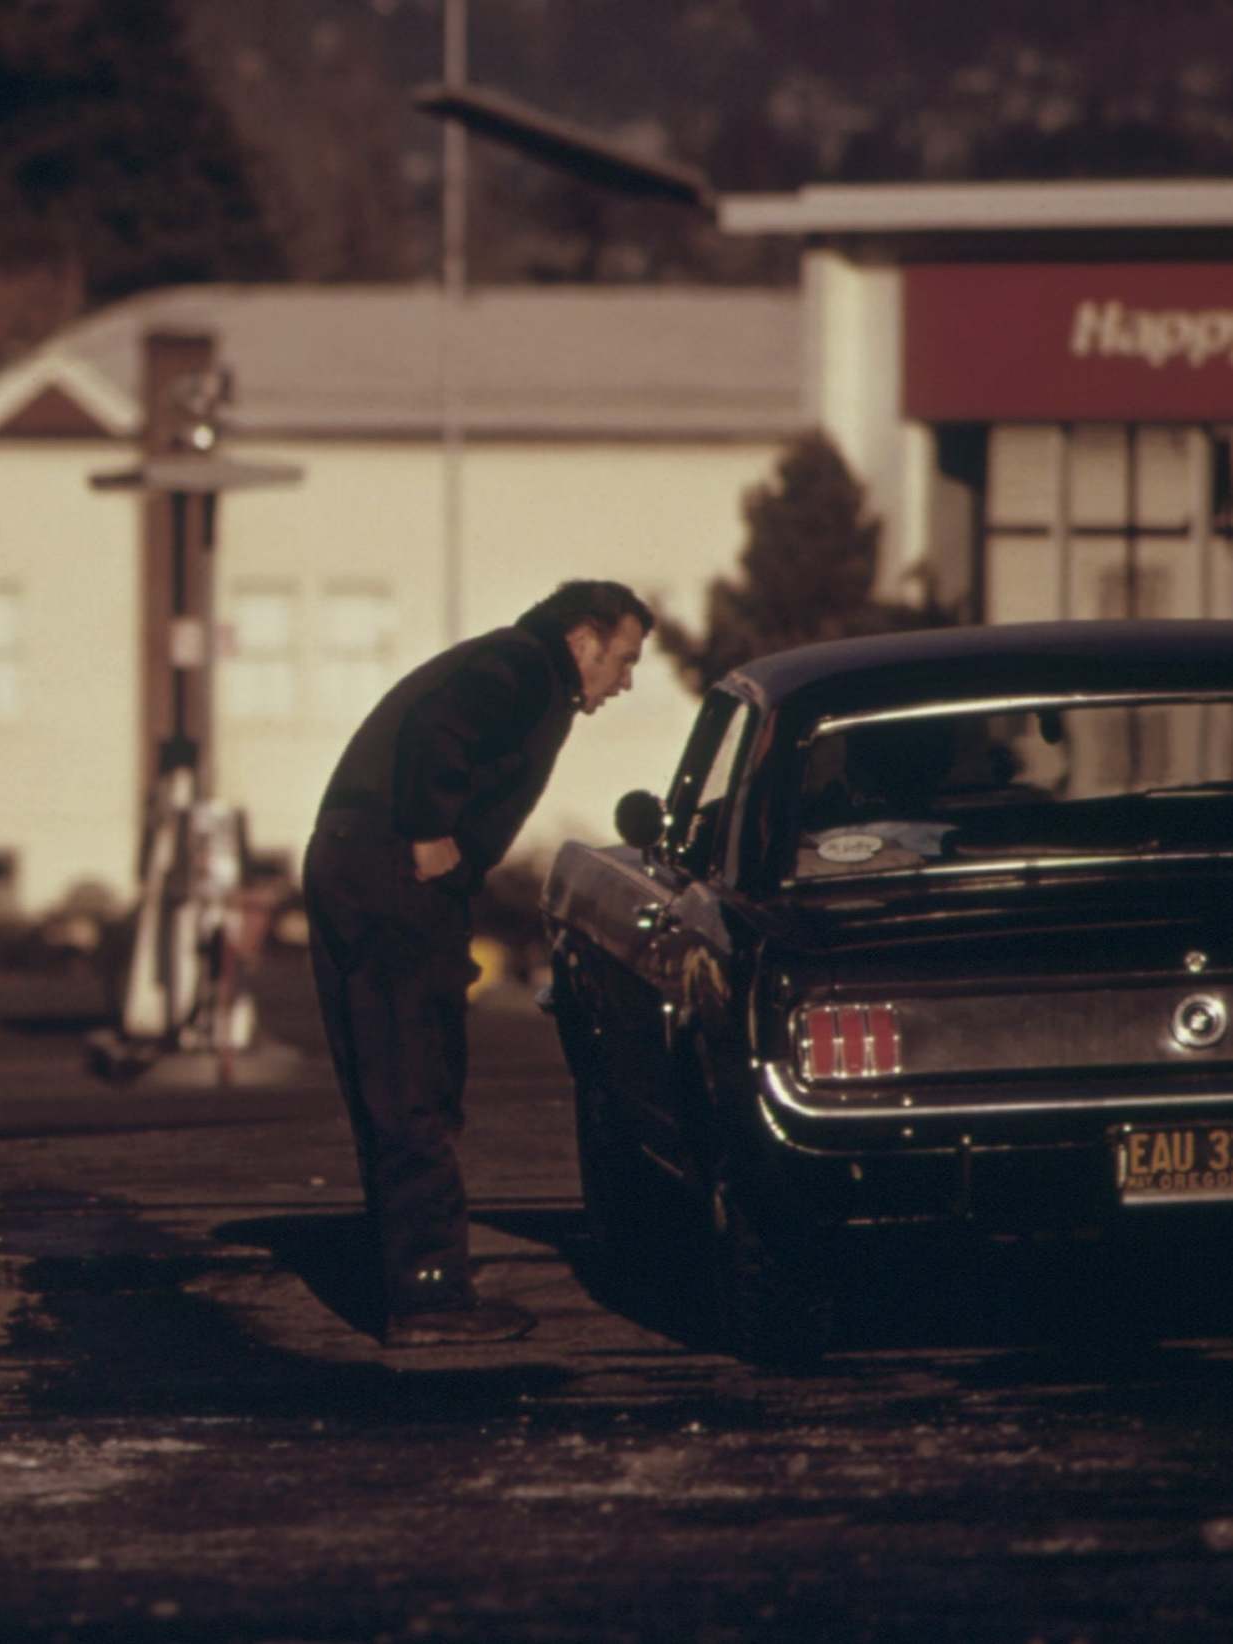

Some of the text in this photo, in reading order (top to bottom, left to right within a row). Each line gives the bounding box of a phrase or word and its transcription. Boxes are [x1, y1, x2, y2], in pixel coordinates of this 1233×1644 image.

[1070, 298, 1233, 368] Happ
[1129, 1131, 1194, 1174] EAU
[1158, 1171, 1233, 1190] OREGO
